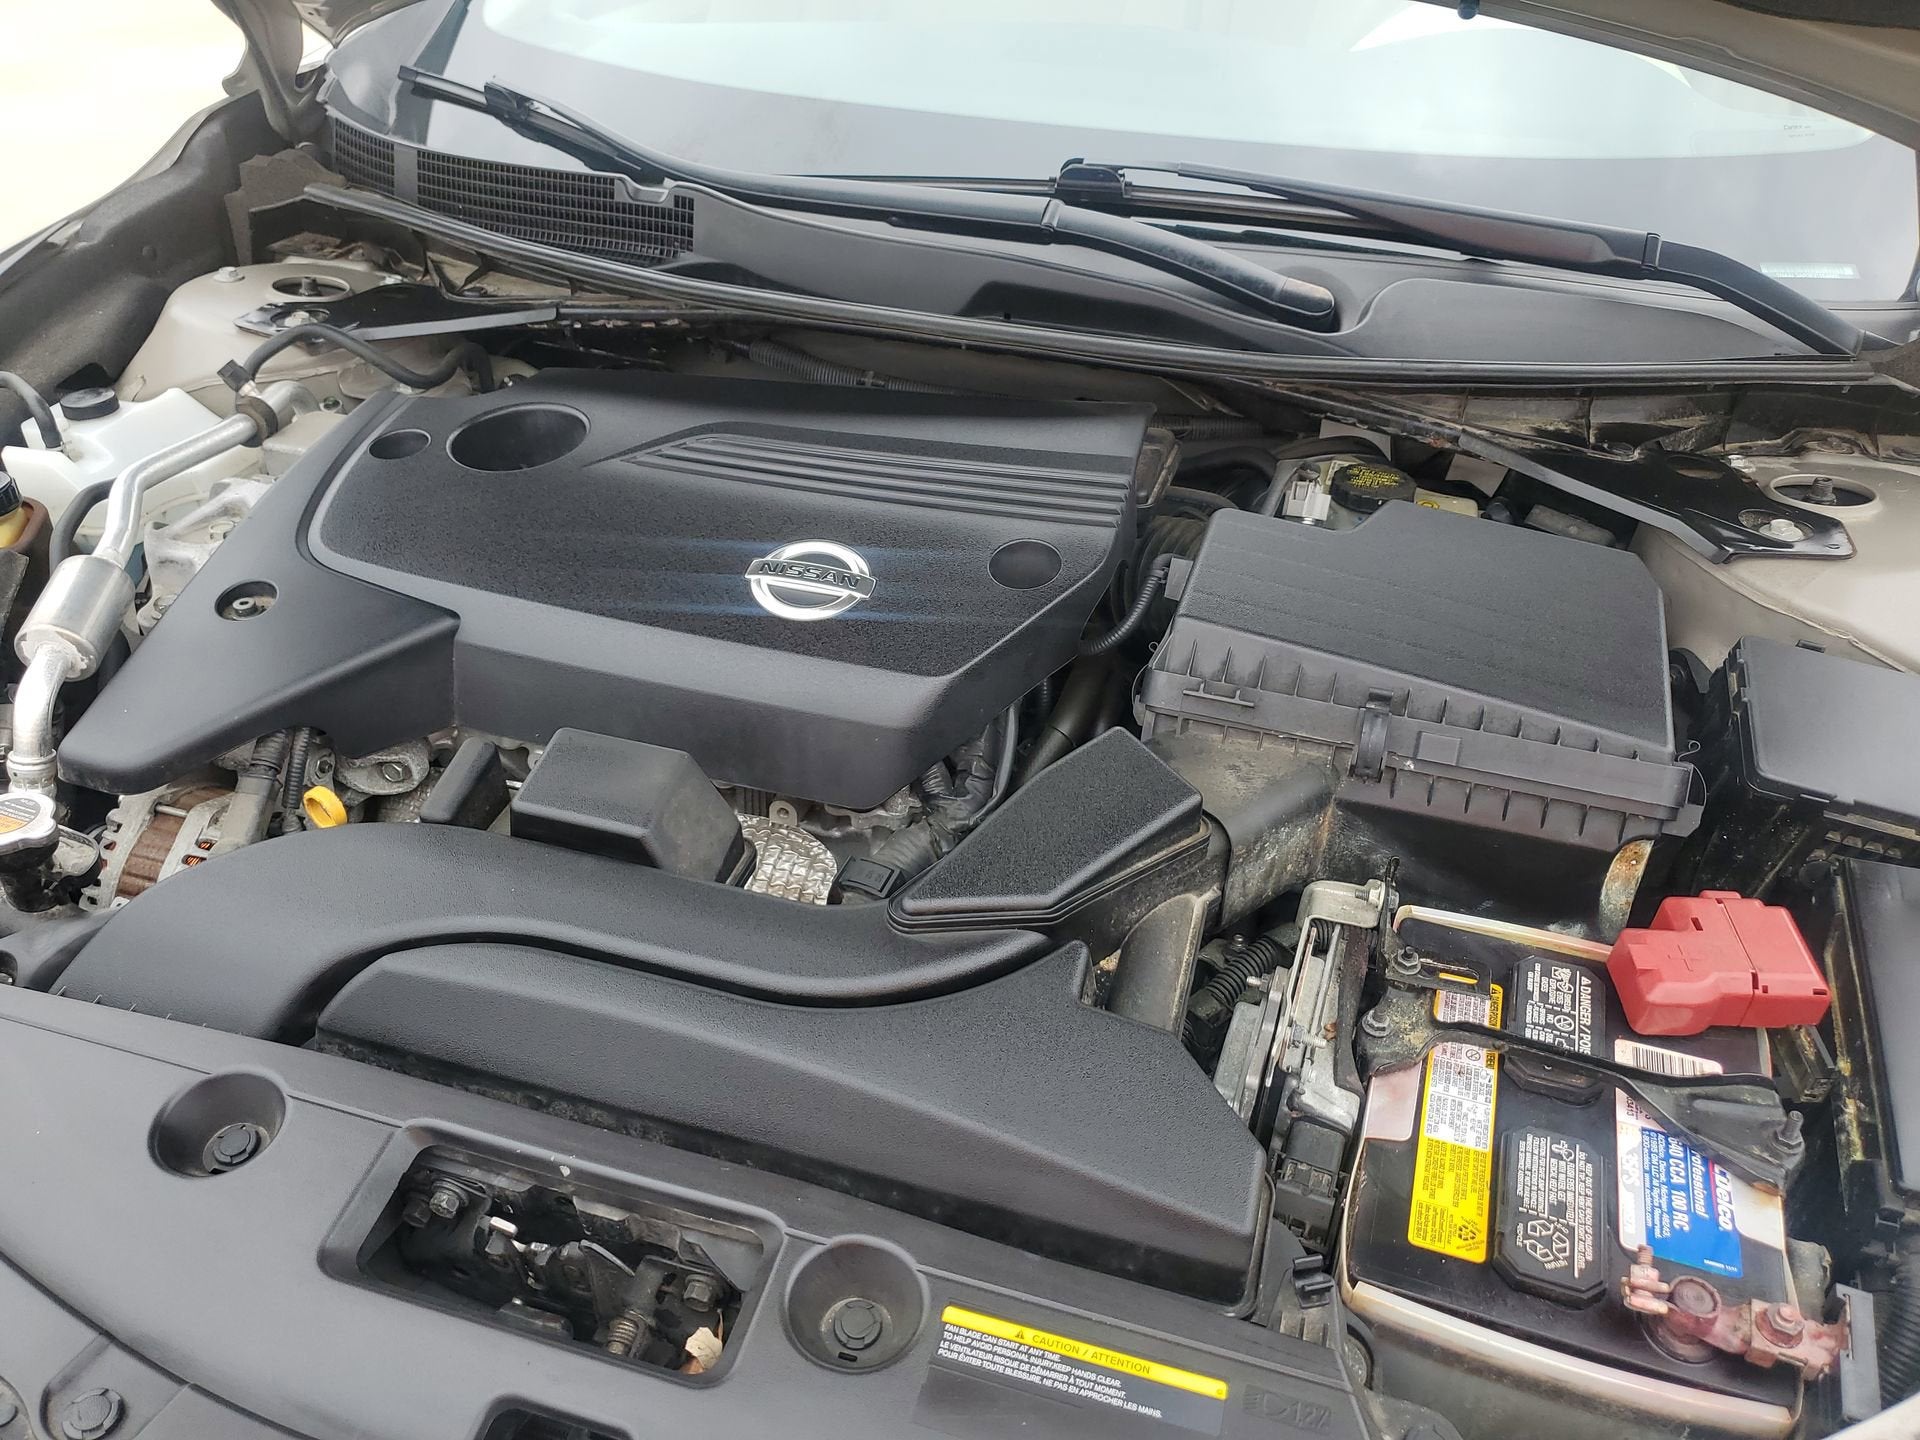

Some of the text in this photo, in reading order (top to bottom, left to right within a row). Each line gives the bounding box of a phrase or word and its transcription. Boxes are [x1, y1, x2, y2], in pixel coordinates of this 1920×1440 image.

[759, 562, 861, 589] NISSAN
[1546, 1014, 1554, 1024] NO
[1651, 1153, 1658, 1165] GM
[1670, 1158, 1686, 1184] CCA
[1651, 1186, 1660, 1208] Rights
[1691, 1151, 1709, 1218] rofessional
[1671, 1190, 1688, 1211] 100
[1672, 1211, 1689, 1232] RC
[944, 1323, 959, 1332] FAN
[960, 1327, 982, 1339] BLADE
[982, 1333, 998, 1344] CAN
[998, 1338, 1020, 1350] START
[1019, 1344, 1029, 1353] AT
[1028, 1346, 1044, 1356] ANY
[943, 1331, 953, 1340] TO
[954, 1334, 972, 1346] HELP
[970, 1339, 993, 1352] AVOID
[992, 1345, 1029, 1361] PERSONAL
[1071, 1367, 1097, 1381] HANDS
[1097, 1374, 1122, 1388] CLEAR.
[1032, 1334, 1080, 1354] CAUTION
[1091, 1351, 1151, 1375] ATTENTION
[938, 1347, 1163, 1419] POUR ÉVITER TOUTE BLESSURE, NE PAS EN APPROCHER LES MAINS.
[940, 1340, 950, 1349] LE
[950, 1343, 993, 1361] VENTILATEUR
[993, 1355, 1020, 1369] RISQUE
[1020, 1362, 1031, 1372] DE
[1031, 1364, 1070, 1383] DÉMARRER
[1075, 1378, 1095, 1390] TOUT
[1094, 1384, 1127, 1399] MOMENT.
